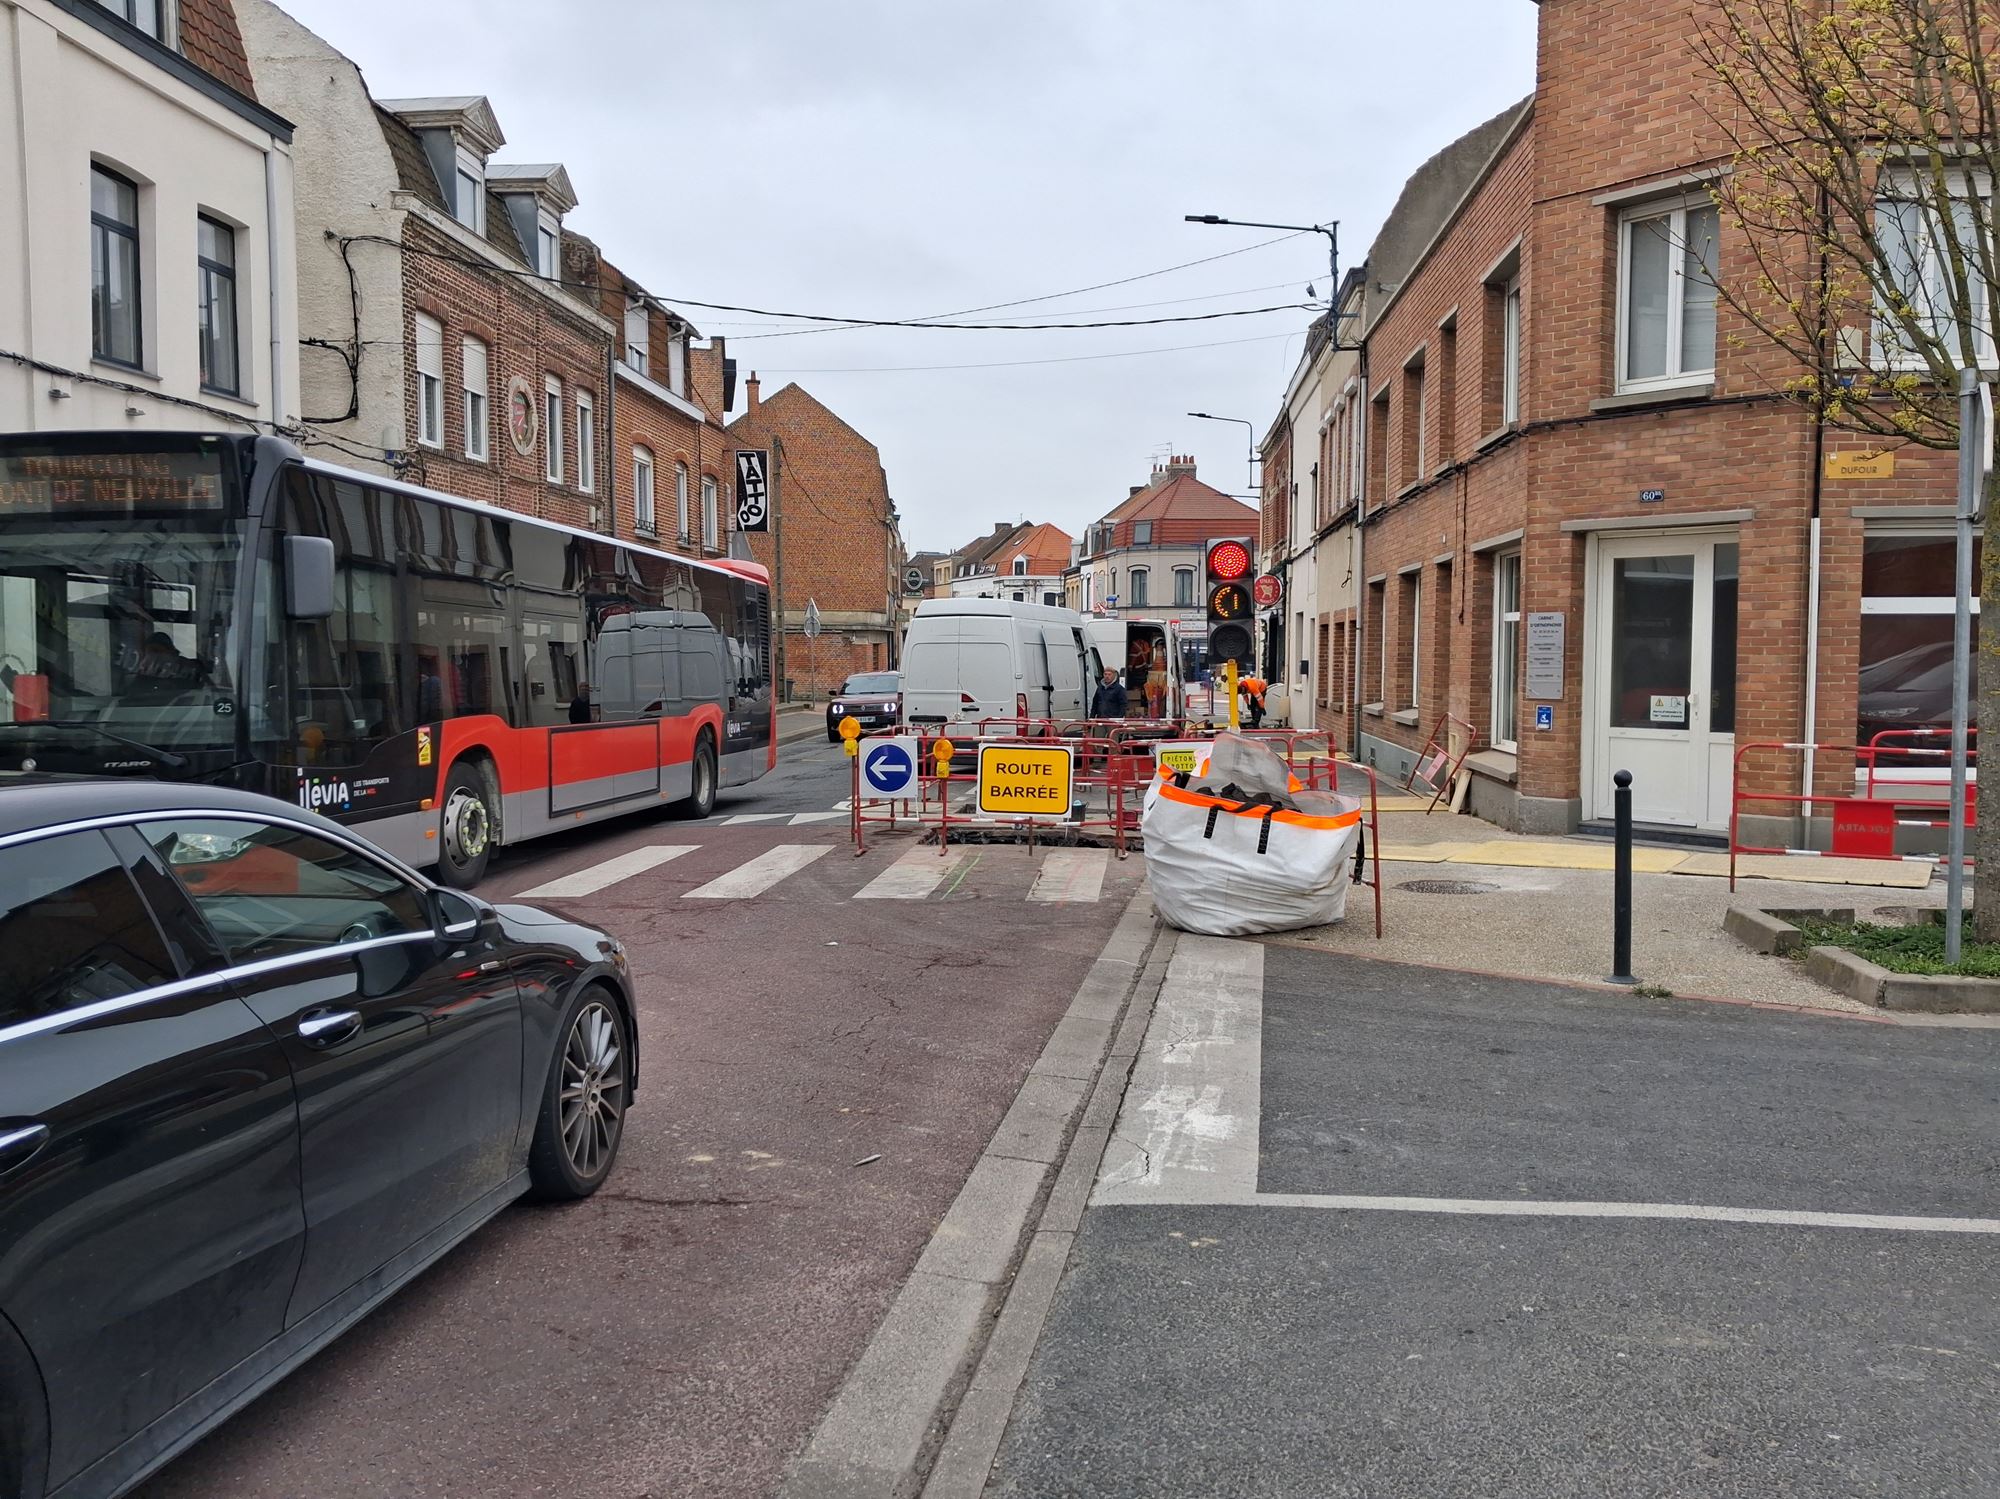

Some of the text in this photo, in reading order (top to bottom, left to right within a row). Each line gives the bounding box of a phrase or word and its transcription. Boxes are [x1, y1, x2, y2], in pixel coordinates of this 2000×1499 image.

[1840, 465, 1878, 474] DUFOUR
[54, 479, 85, 502] DE
[738, 452, 763, 523] TATTOO
[217, 702, 232, 713] 25
[996, 762, 1053, 776] ROUTE
[990, 784, 1059, 799] BARRÉE
